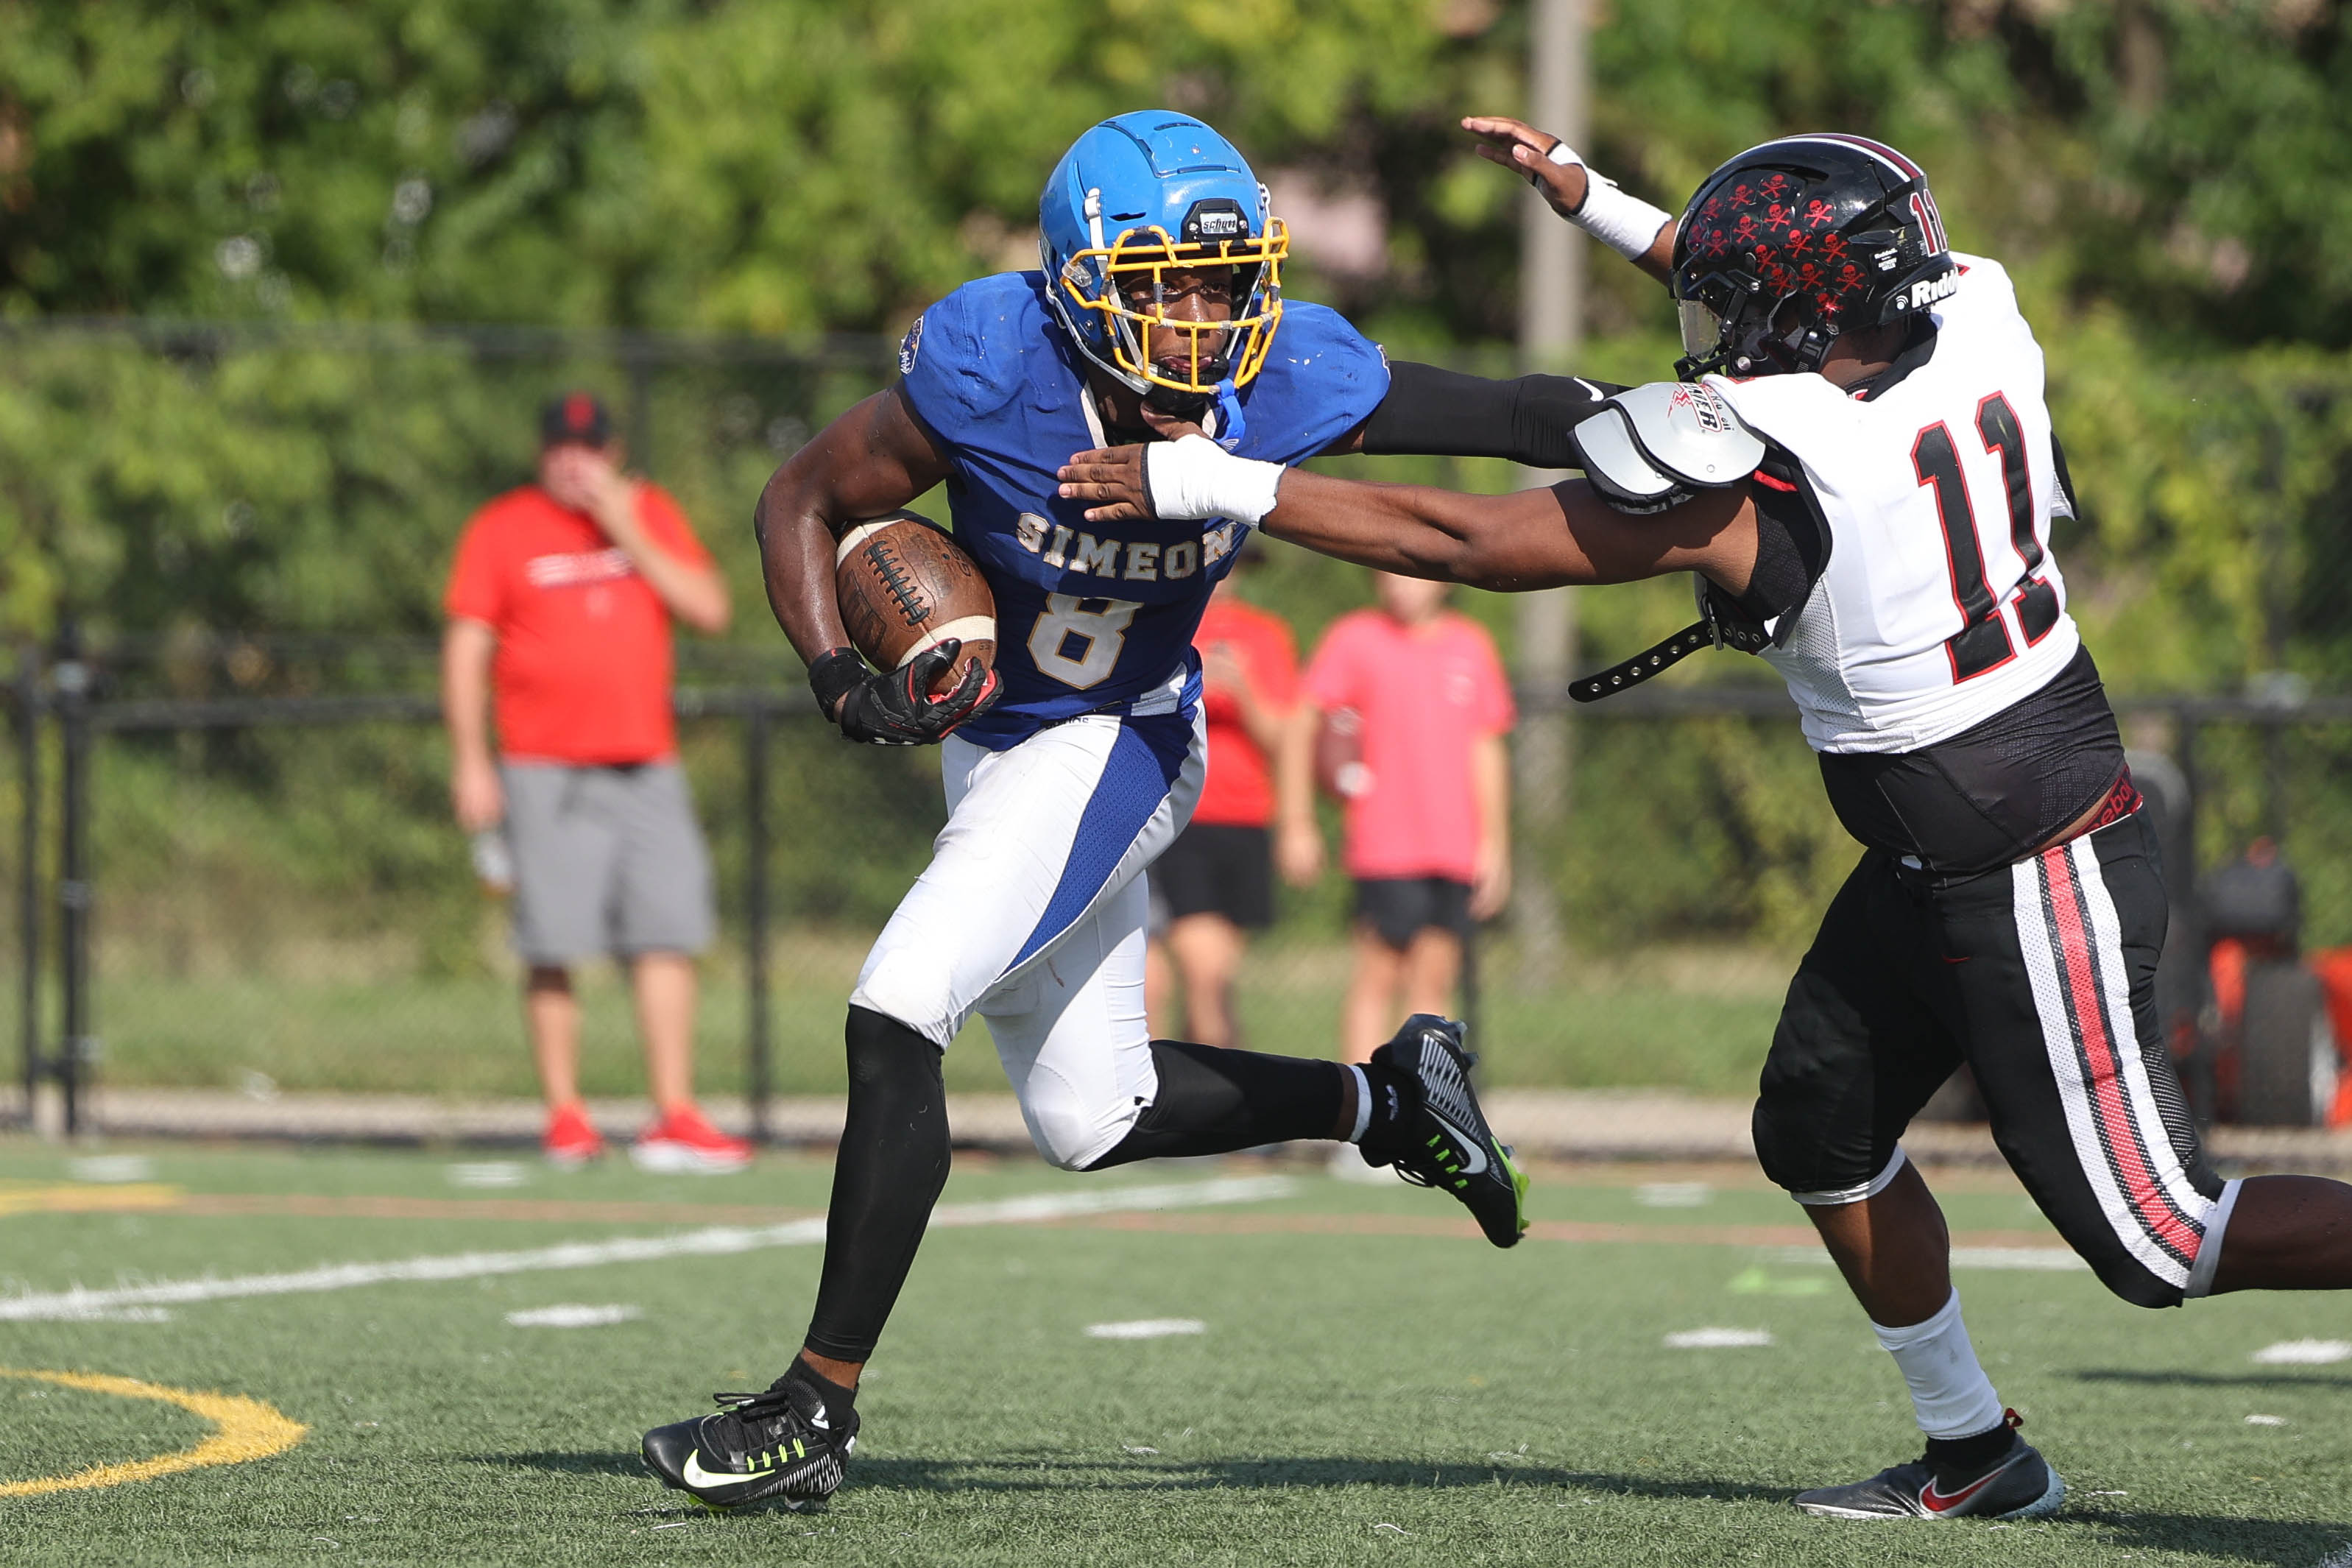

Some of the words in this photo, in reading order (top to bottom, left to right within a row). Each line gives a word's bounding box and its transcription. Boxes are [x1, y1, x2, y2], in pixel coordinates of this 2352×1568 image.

[1203, 218, 1236, 230] schutt
[1910, 188, 1948, 257] 11
[1912, 266, 1958, 308] Ridd
[1015, 512, 1237, 582] SIMEON
[1910, 390, 2060, 685] 11
[1026, 591, 1145, 691] 8
